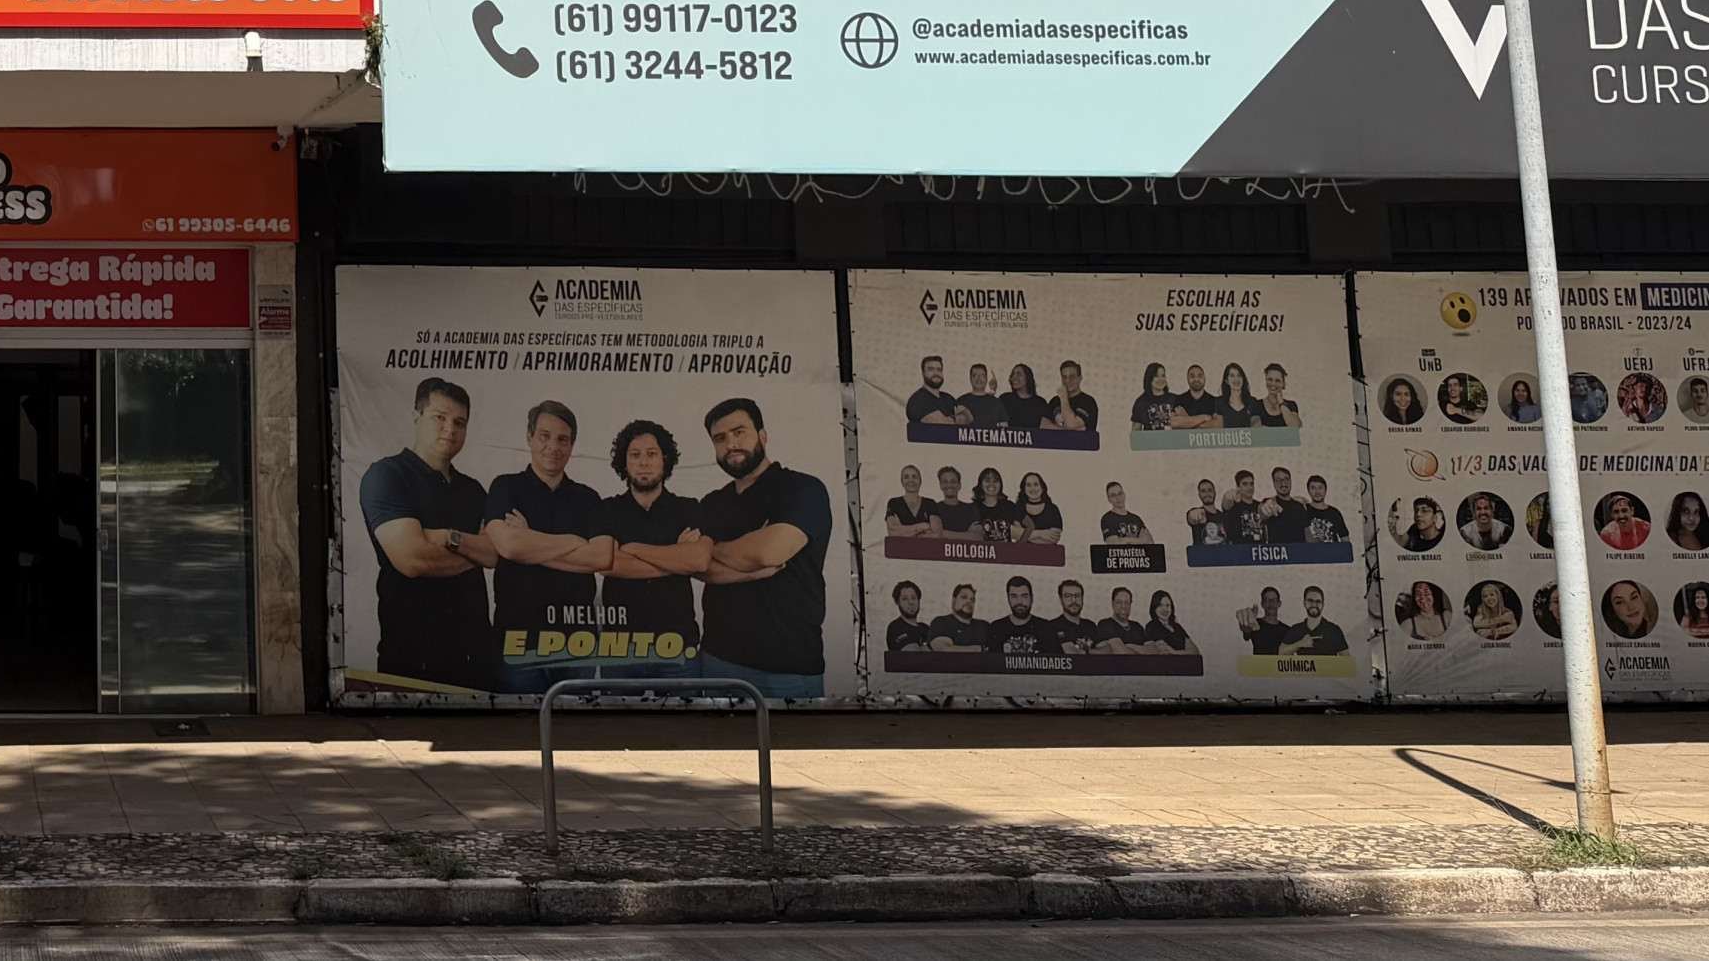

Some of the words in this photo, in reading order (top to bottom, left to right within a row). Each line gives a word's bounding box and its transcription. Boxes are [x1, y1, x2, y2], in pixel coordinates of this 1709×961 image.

[554, 4, 613, 36] (61)
[623, 4, 798, 33] 99117-0123
[912, 18, 1188, 42] @academiadasespecificas
[556, 50, 615, 82] (61)
[624, 50, 792, 80] 3244-5812
[914, 49, 1211, 68] www.academiadasespecificas.com.br
[155, 217, 174, 232] 61
[179, 217, 291, 233] 99305-6446
[98, 253, 216, 285] Rápida
[555, 279, 642, 300] ACADEMIA
[944, 289, 1027, 309] ACADEMIA
[1166, 289, 1235, 307] ESCOLHA
[1240, 290, 1260, 307] AS
[1480, 288, 1507, 306] 139
[1615, 288, 1637, 307] EM
[1135, 314, 1175, 332] SUAS
[1180, 311, 1284, 332] ESPECÍFICAS!
[1581, 316, 1623, 330] BRASIL
[1637, 315, 1692, 330] 2023/24
[443, 331, 500, 345] ACADEMIA
[503, 332, 524, 345] DAS
[528, 331, 596, 346] ESPECÍFICAS
[600, 333, 622, 347] TEM
[626, 333, 708, 348] METODOLOGIA
[712, 334, 752, 348] TRIPLO
[385, 349, 508, 371] ACOLHIMENTO
[523, 351, 673, 373] APRIMORAMENTO
[688, 352, 792, 377] APROVAÇÃO
[1624, 357, 1653, 371] UERJ
[958, 427, 1034, 446] MATEMÁTICA
[1189, 429, 1253, 448] PORTUGUÊS
[1488, 455, 1516, 471] DAS
[1579, 455, 1598, 471] DE
[1603, 455, 1673, 471] MEDICINA
[1680, 455, 1698, 472] DA
[944, 543, 997, 560] BIOLOGIA
[1252, 544, 1288, 561] FÍSICA
[1119, 556, 1151, 569] PROVAS
[563, 605, 628, 626] MELHOR
[536, 630, 698, 659] PONTO.
[1005, 656, 1074, 671] HUMANIDADES
[1277, 657, 1316, 673] QUÍMICA
[1619, 657, 1670, 670] ACADEMIA
